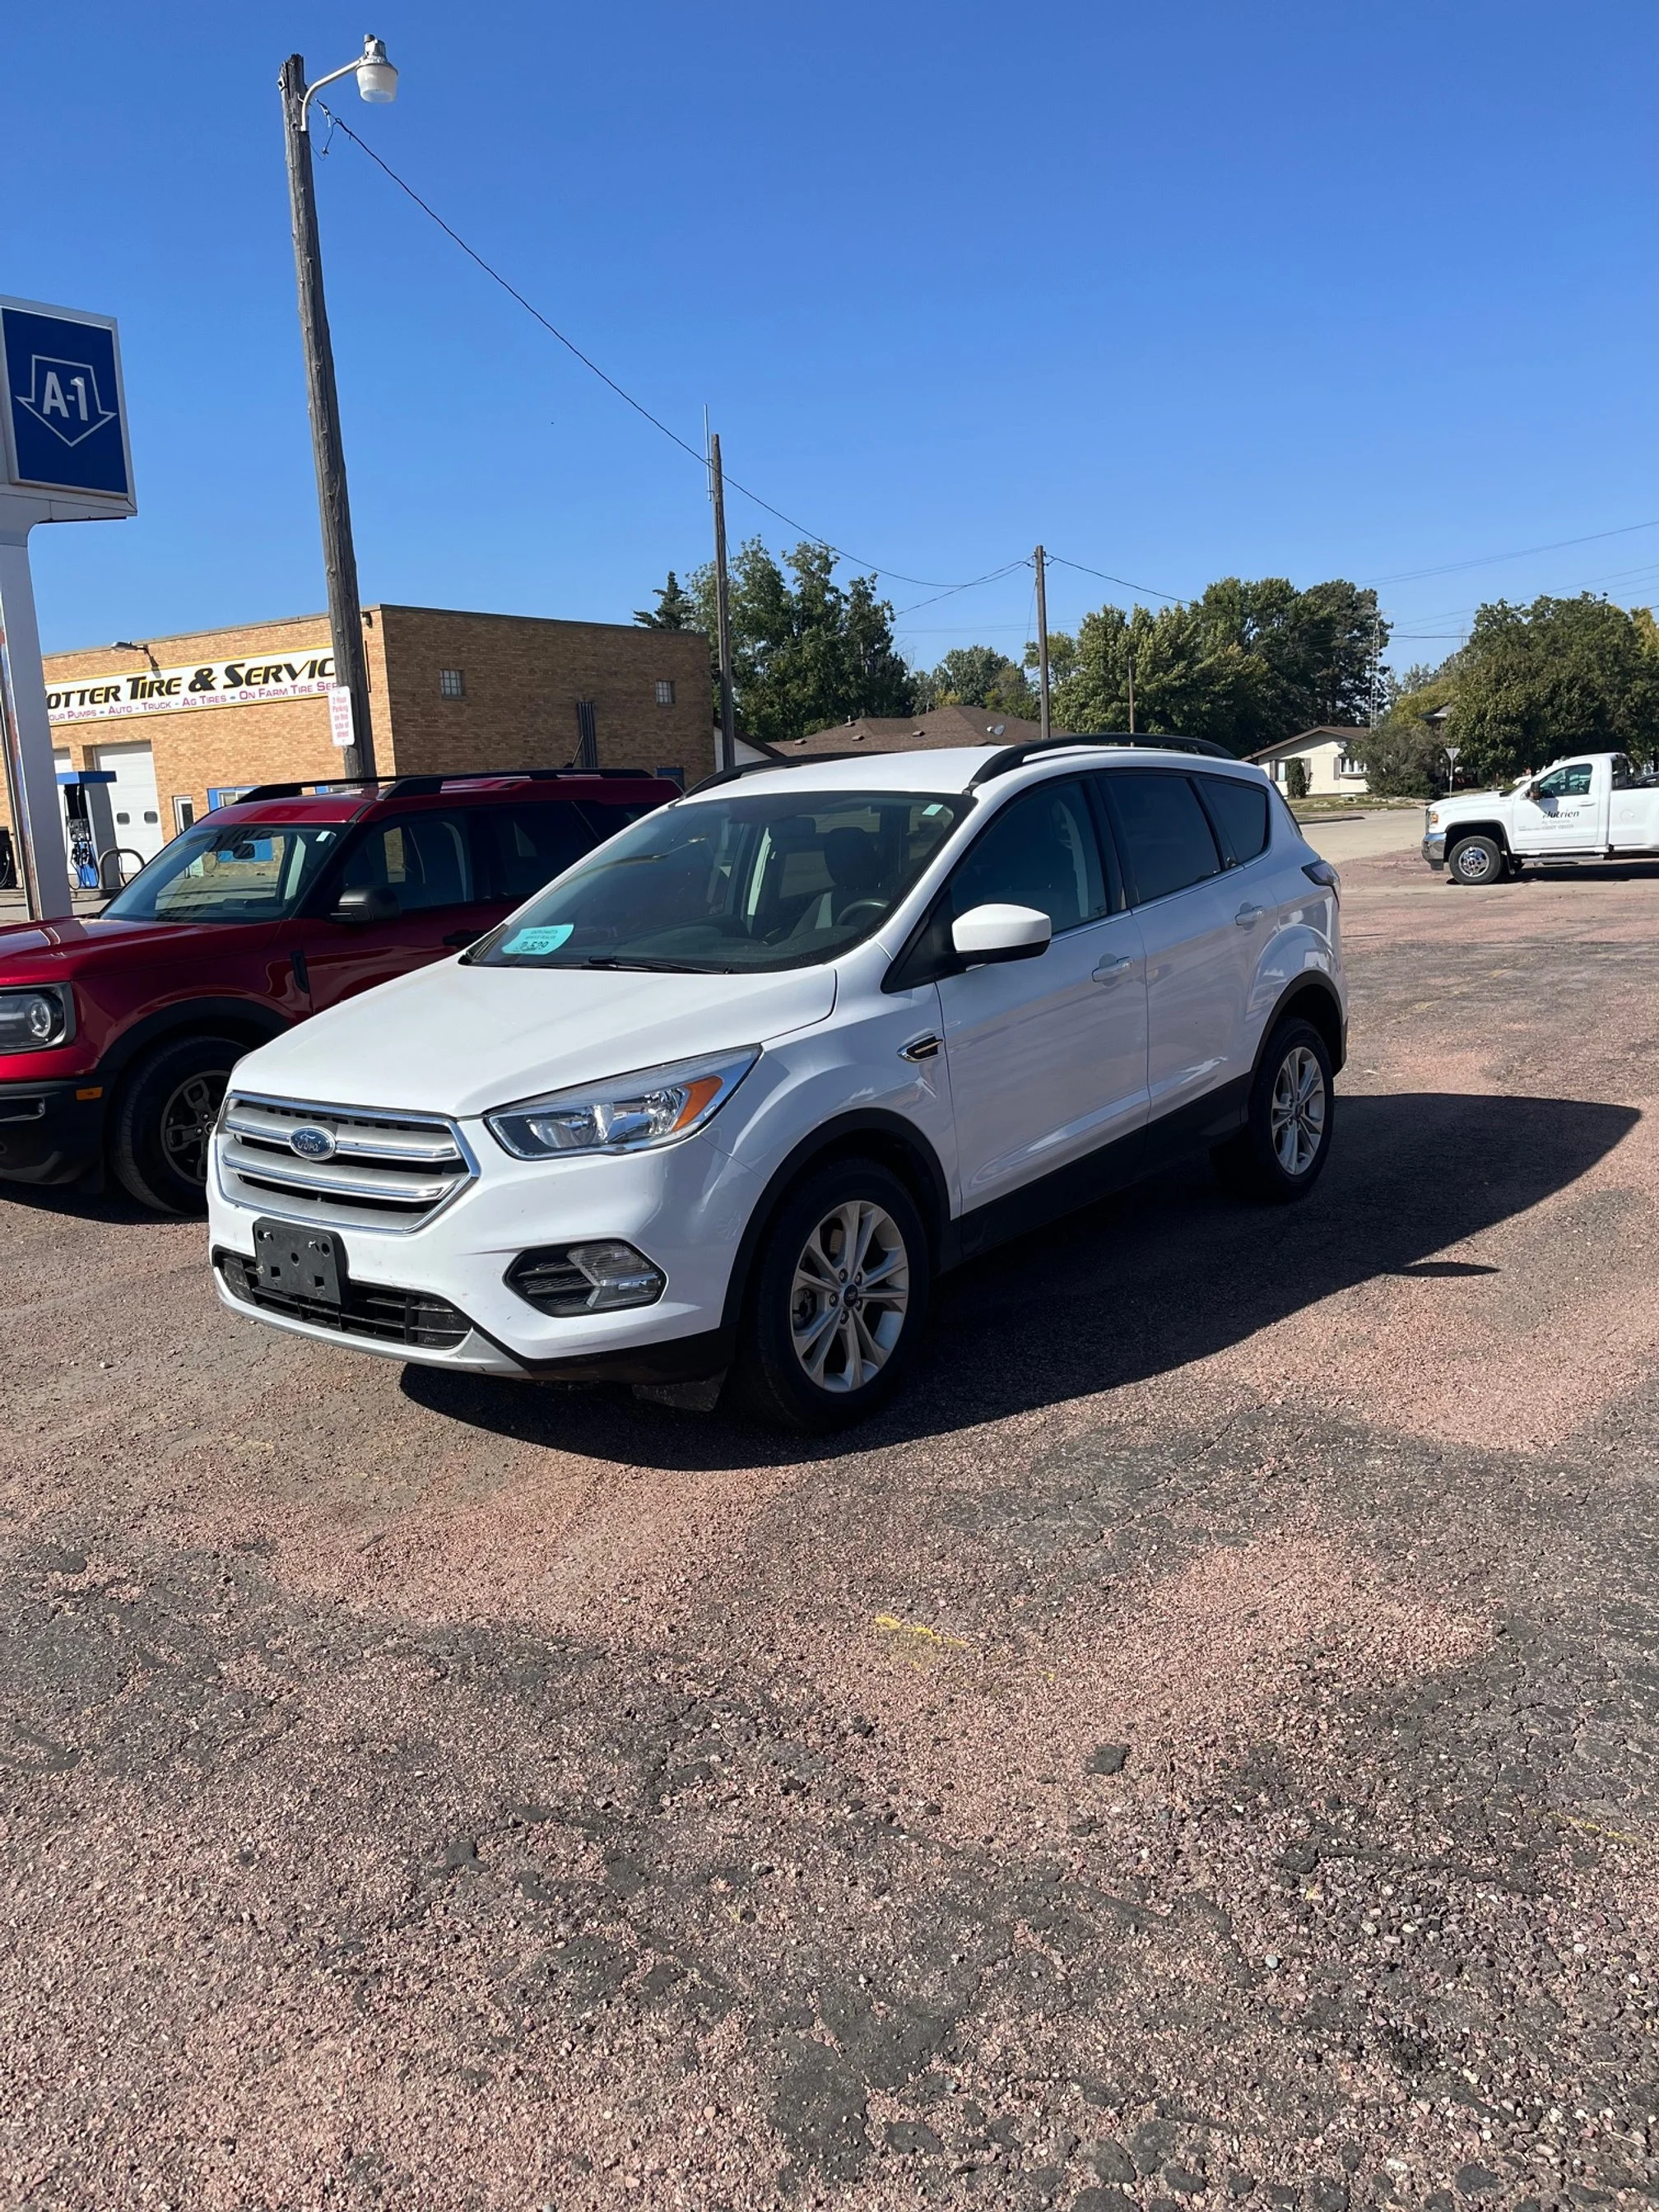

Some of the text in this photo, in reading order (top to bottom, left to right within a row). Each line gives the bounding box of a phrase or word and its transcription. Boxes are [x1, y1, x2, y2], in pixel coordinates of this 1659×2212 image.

[42, 371, 88, 421] A-1
[45, 658, 335, 709] OTTER TIRE & SERVIC
[49, 713, 65, 722] OUR
[67, 709, 97, 720] PUMPS
[109, 705, 132, 715] AUTO
[142, 701, 172, 711] TRUCK
[199, 695, 227, 704] TIRES
[239, 690, 256, 700] ON
[258, 687, 288, 698] FARM
[290, 684, 314, 695] TIRE
[317, 681, 337, 691] SER
[1542, 808, 1579, 819] Nutrien
[295, 1131, 322, 1152] Ford
